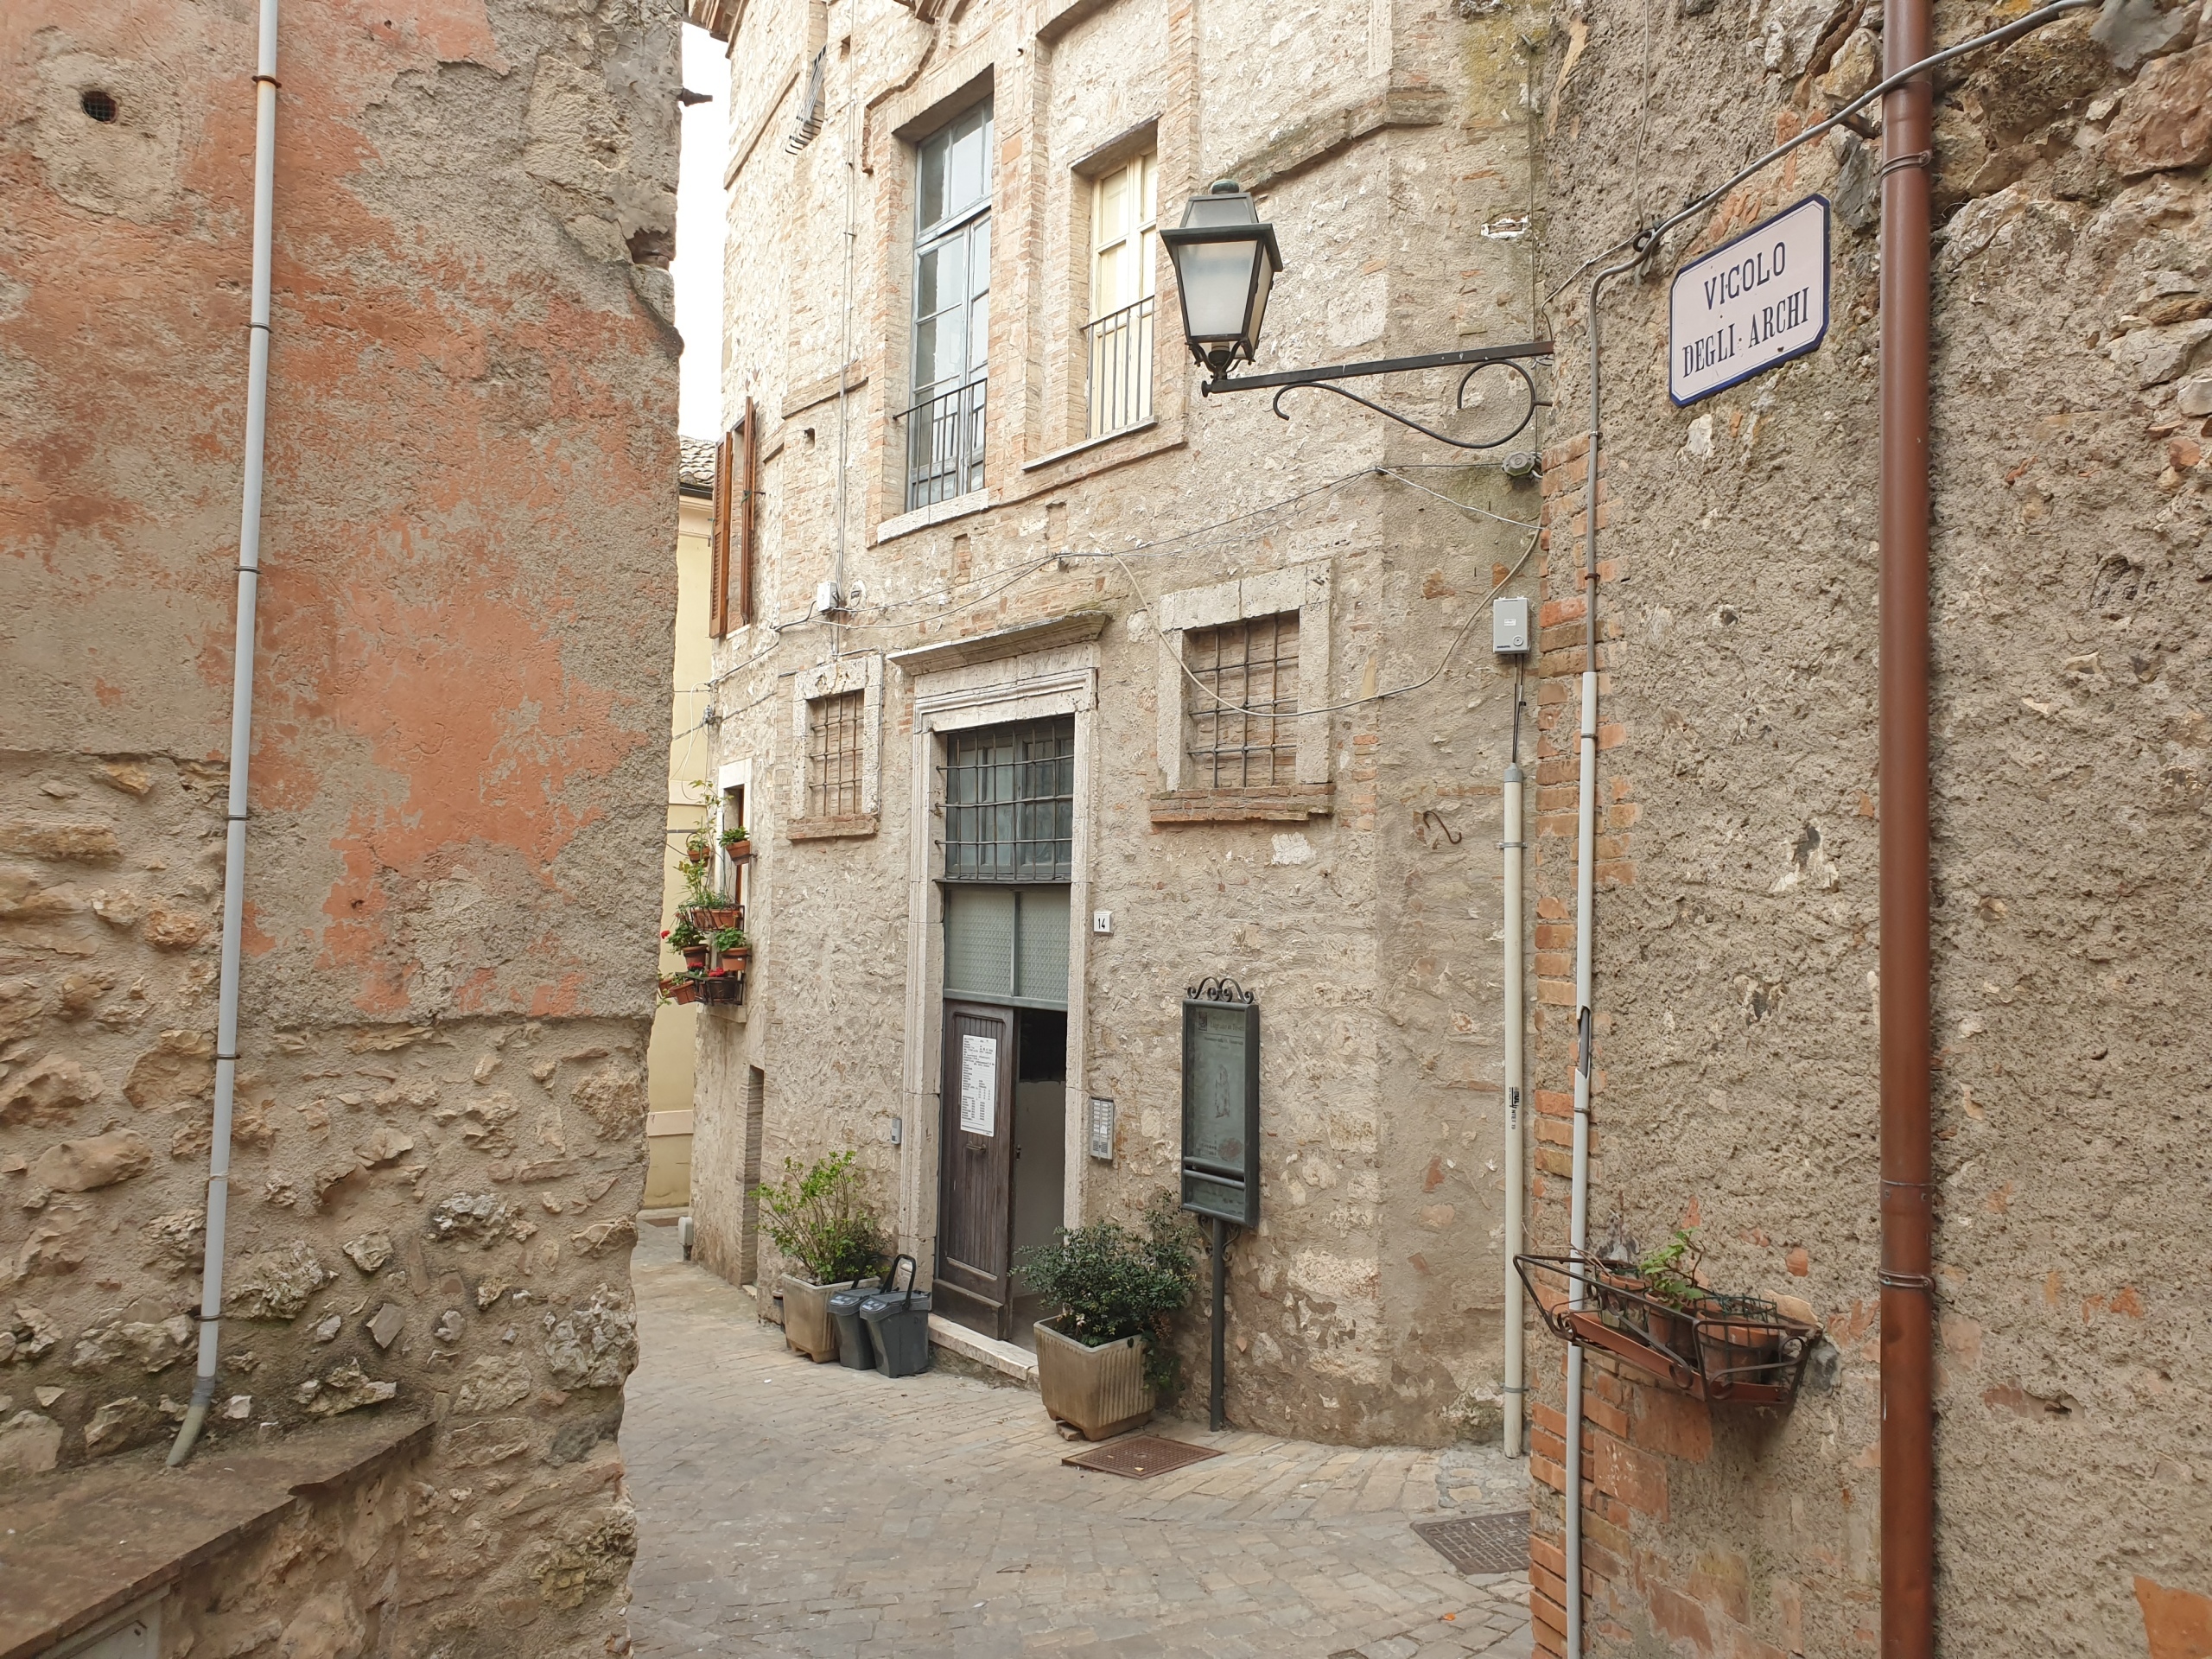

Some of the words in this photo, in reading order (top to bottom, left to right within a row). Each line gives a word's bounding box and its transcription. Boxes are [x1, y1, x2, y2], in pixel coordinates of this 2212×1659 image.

[1704, 241, 1786, 311] VICOLO
[1682, 323, 1736, 378] DEGLI
[1747, 286, 1809, 349] ARCHI
[1098, 918, 1106, 930] 14
